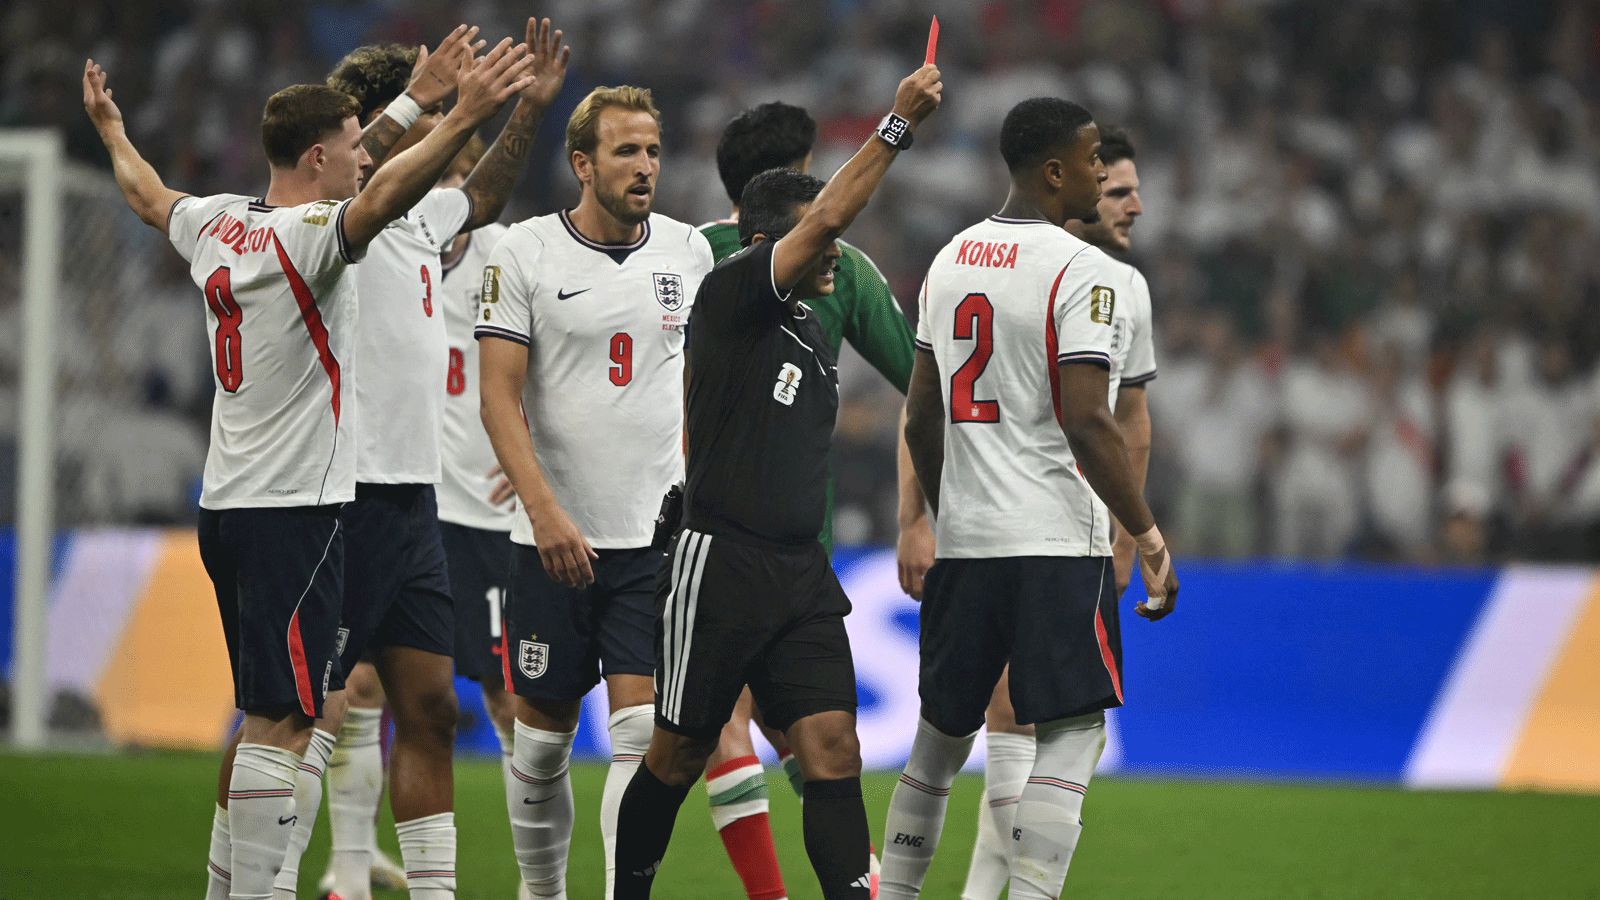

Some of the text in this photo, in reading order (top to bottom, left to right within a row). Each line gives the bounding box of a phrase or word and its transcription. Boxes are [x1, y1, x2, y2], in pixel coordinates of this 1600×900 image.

[955, 239, 1019, 269] KONSA
[420, 264, 433, 318] 3
[204, 265, 243, 393] 8
[608, 332, 633, 387] 9
[950, 292, 1000, 424] 2
[893, 832, 925, 848] ENG
